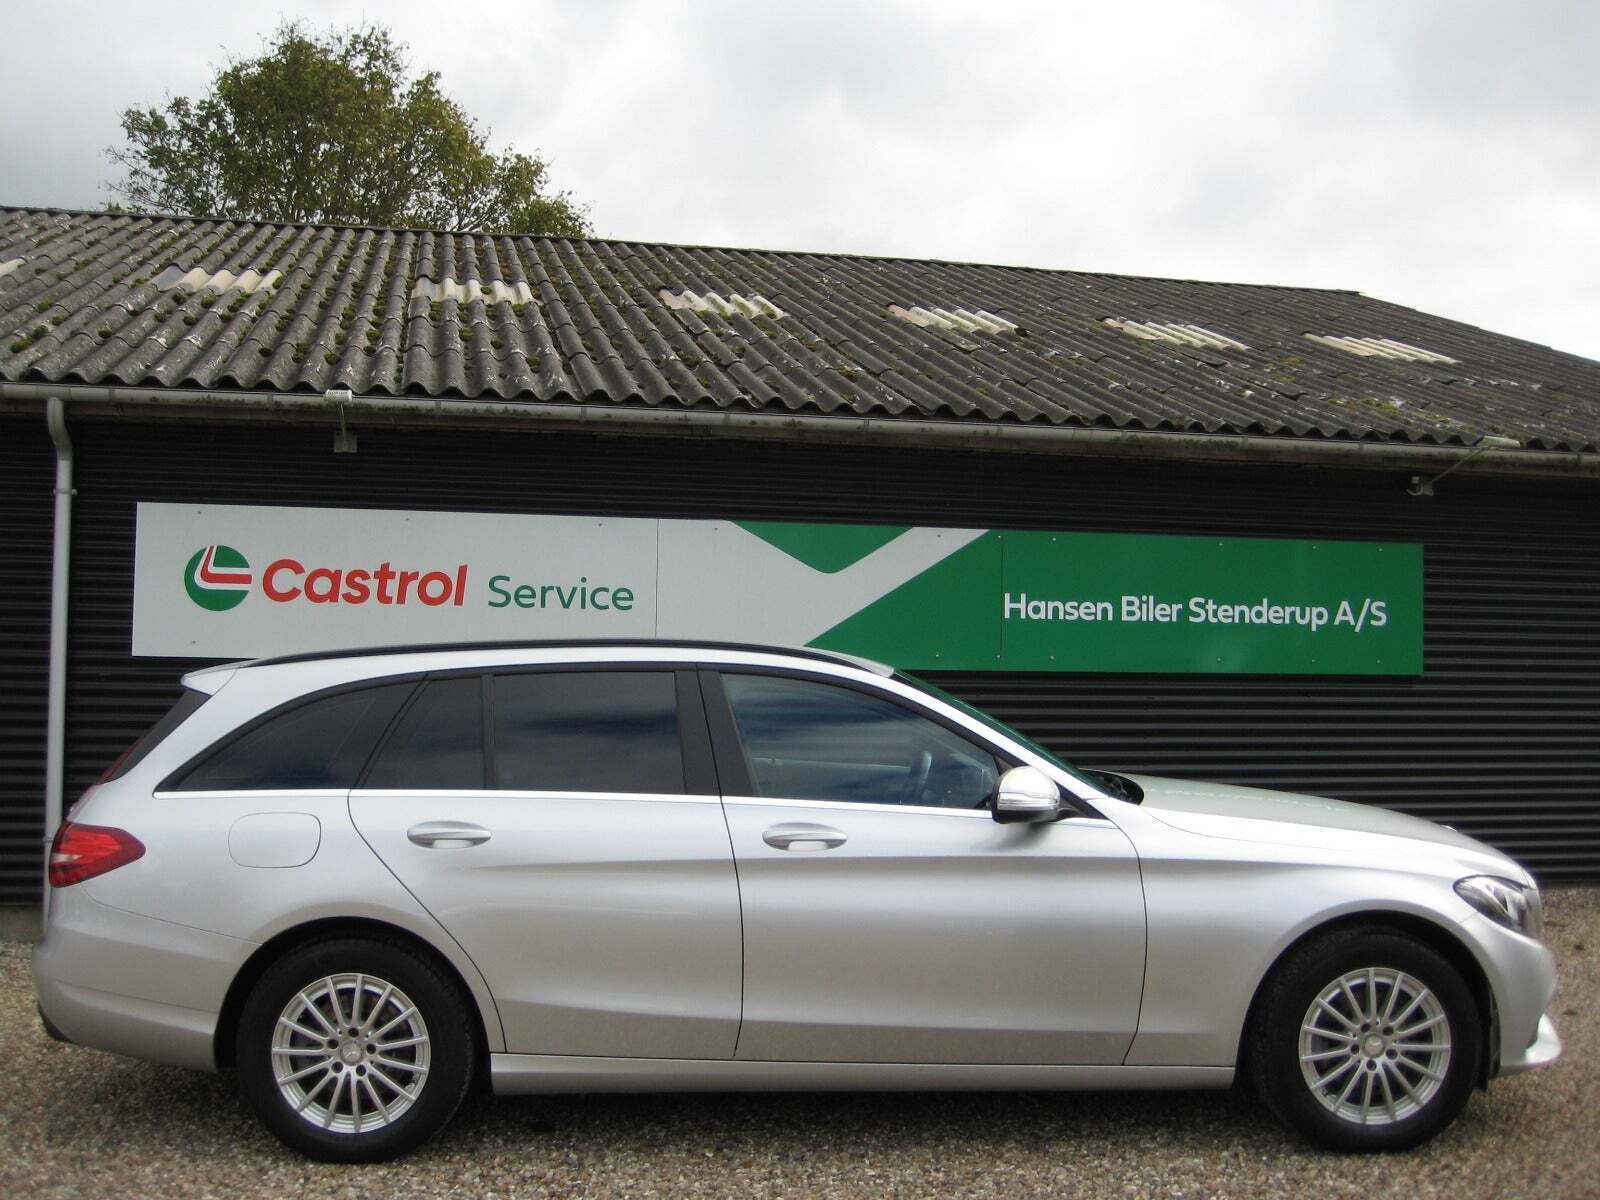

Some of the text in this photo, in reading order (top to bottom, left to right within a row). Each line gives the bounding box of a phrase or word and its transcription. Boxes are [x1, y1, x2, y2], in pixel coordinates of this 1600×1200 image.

[263, 559, 634, 611] Castrol Service
[1003, 592, 1388, 632] Hansen Biler Stenderup A/S
